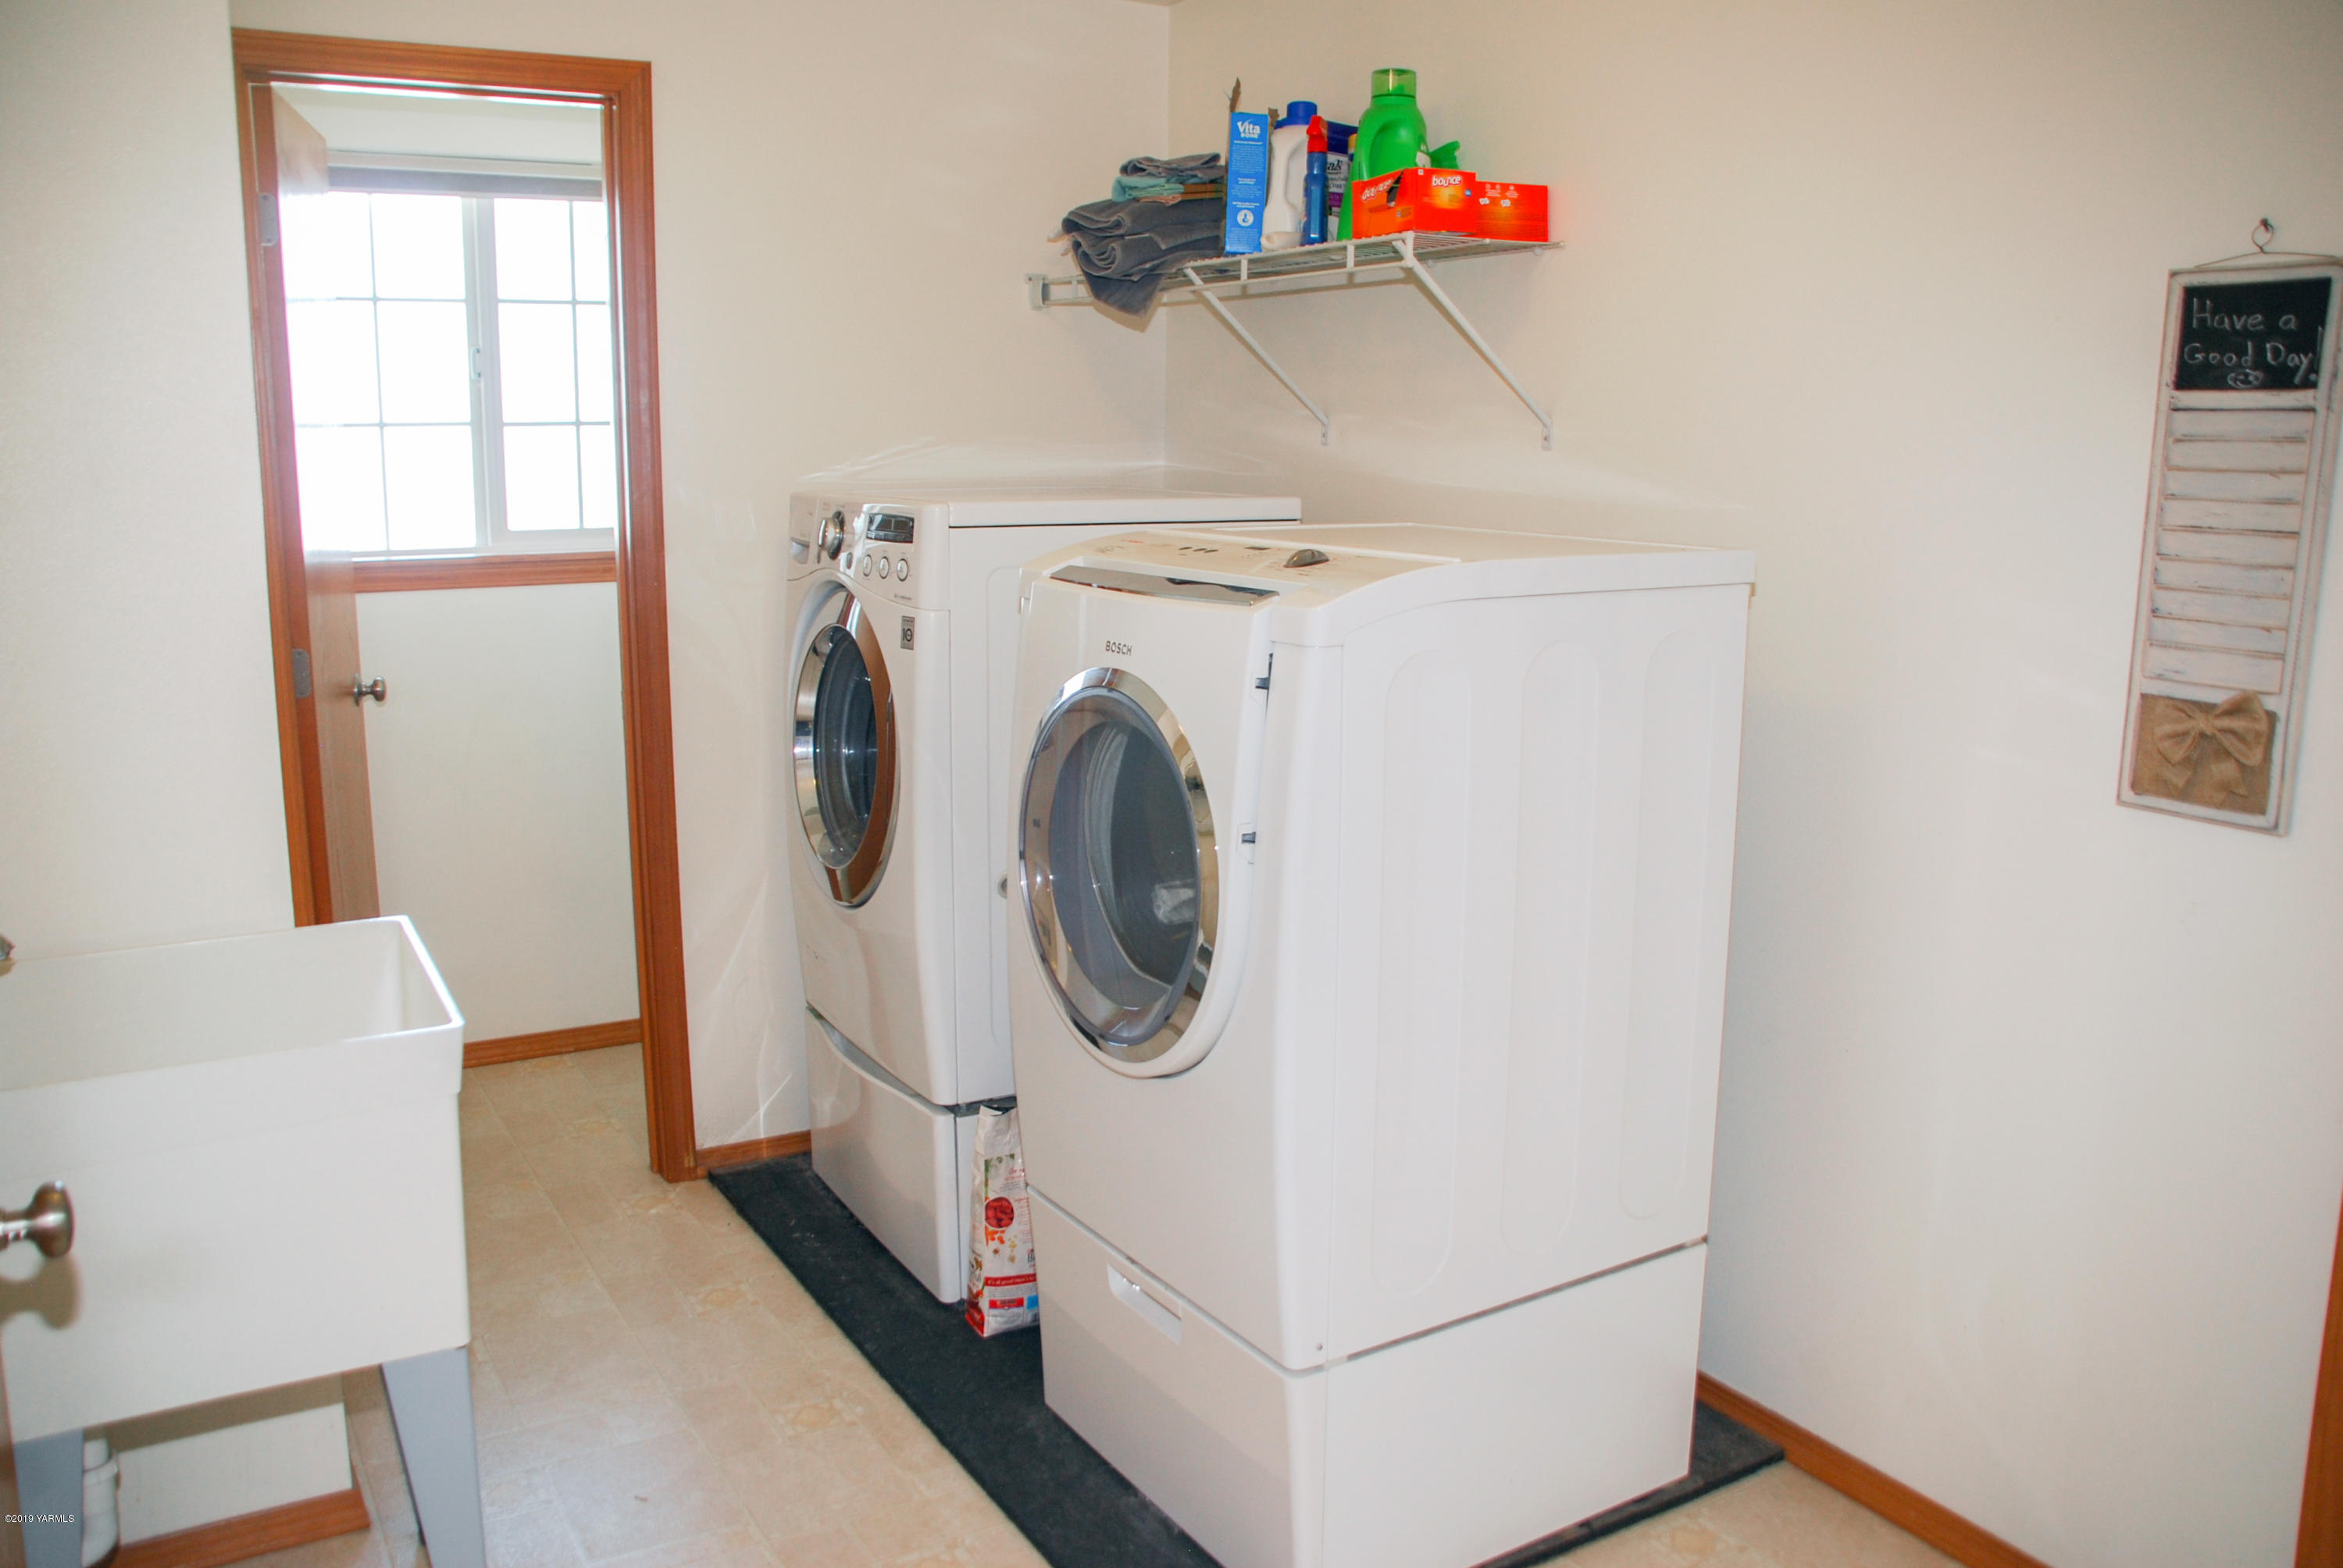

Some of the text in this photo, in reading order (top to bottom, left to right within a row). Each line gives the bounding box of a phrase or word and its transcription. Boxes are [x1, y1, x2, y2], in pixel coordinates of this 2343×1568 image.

[1237, 120, 1261, 134] Vita
[1432, 175, 1463, 187] bounce
[2191, 297, 2297, 331] Have a
[2184, 341, 2254, 367] Good
[1105, 640, 1132, 656] BOSCH
